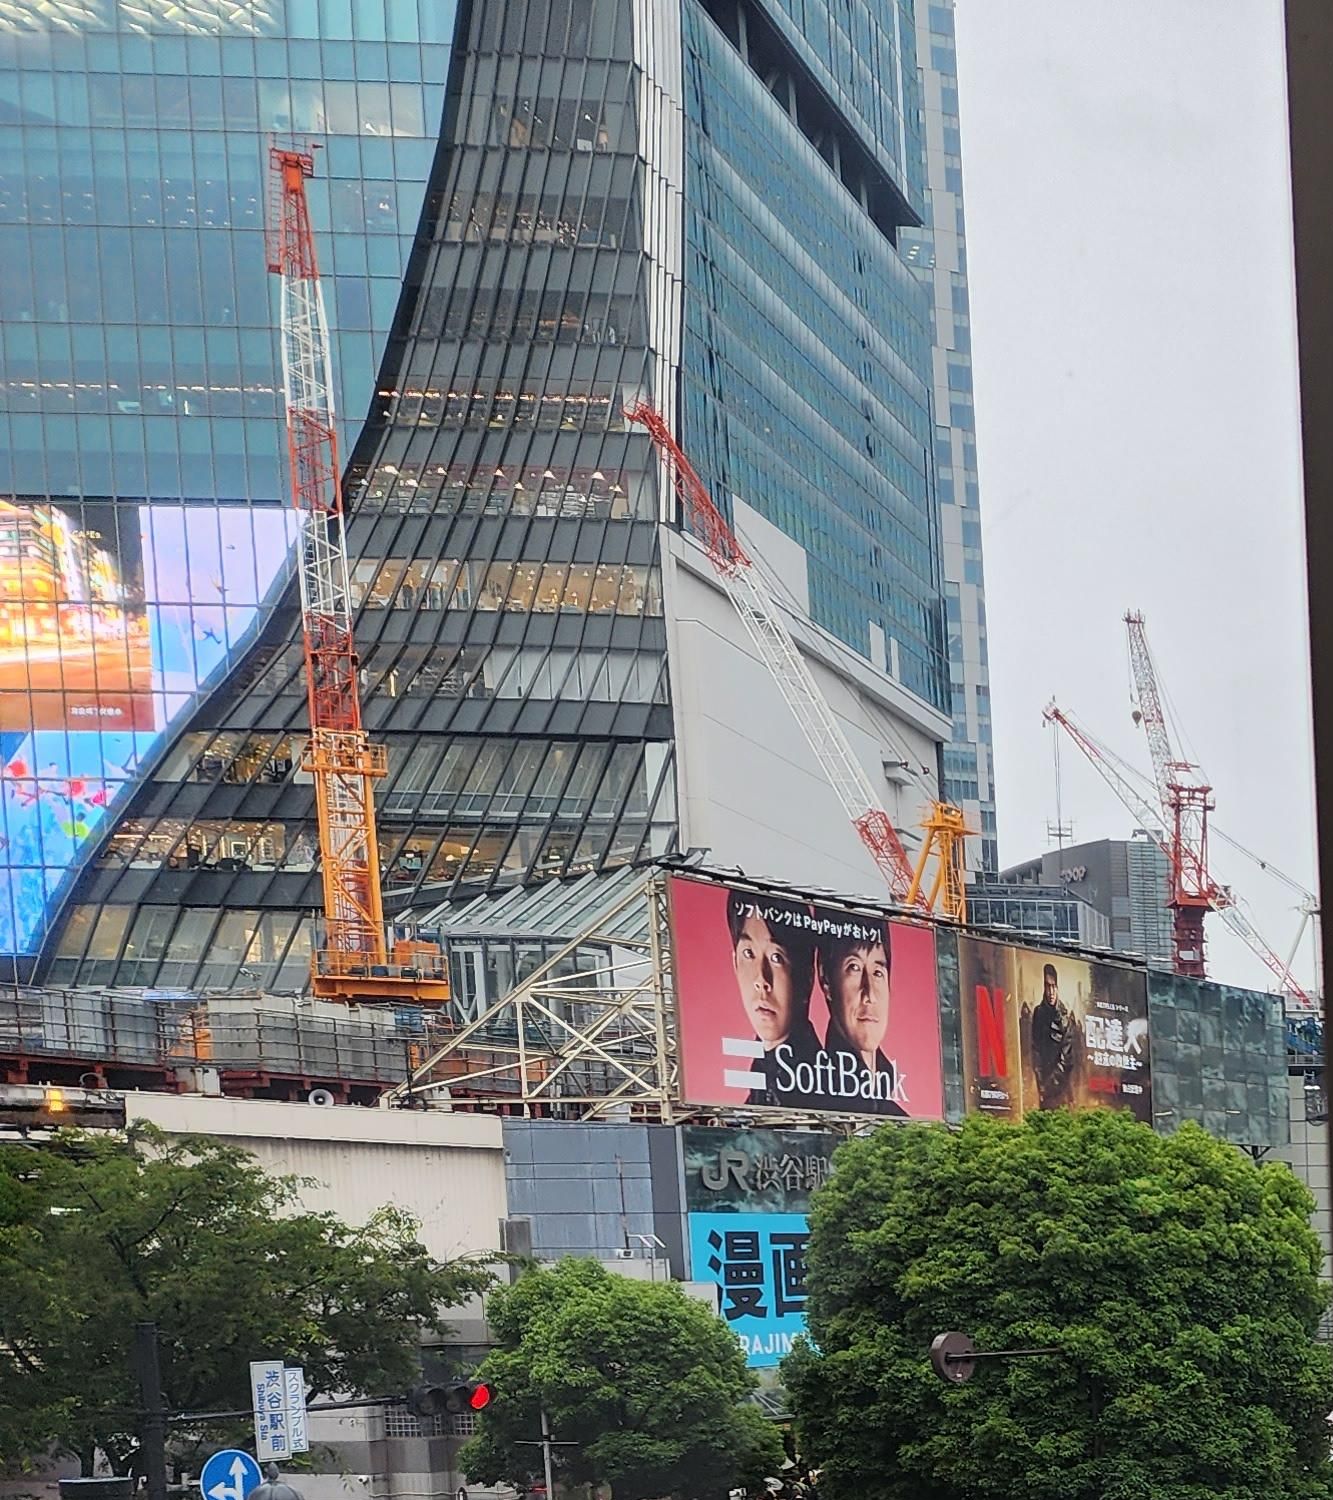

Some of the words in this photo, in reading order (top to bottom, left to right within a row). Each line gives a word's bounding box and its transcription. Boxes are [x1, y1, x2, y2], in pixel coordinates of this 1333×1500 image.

[775, 1043, 910, 1103] SoftBank
[255, 1383, 267, 1422] Shibuya
[265, 1370, 287, 1452] 渋谷駅前
[287, 1371, 305, 1450] スクランブル式
